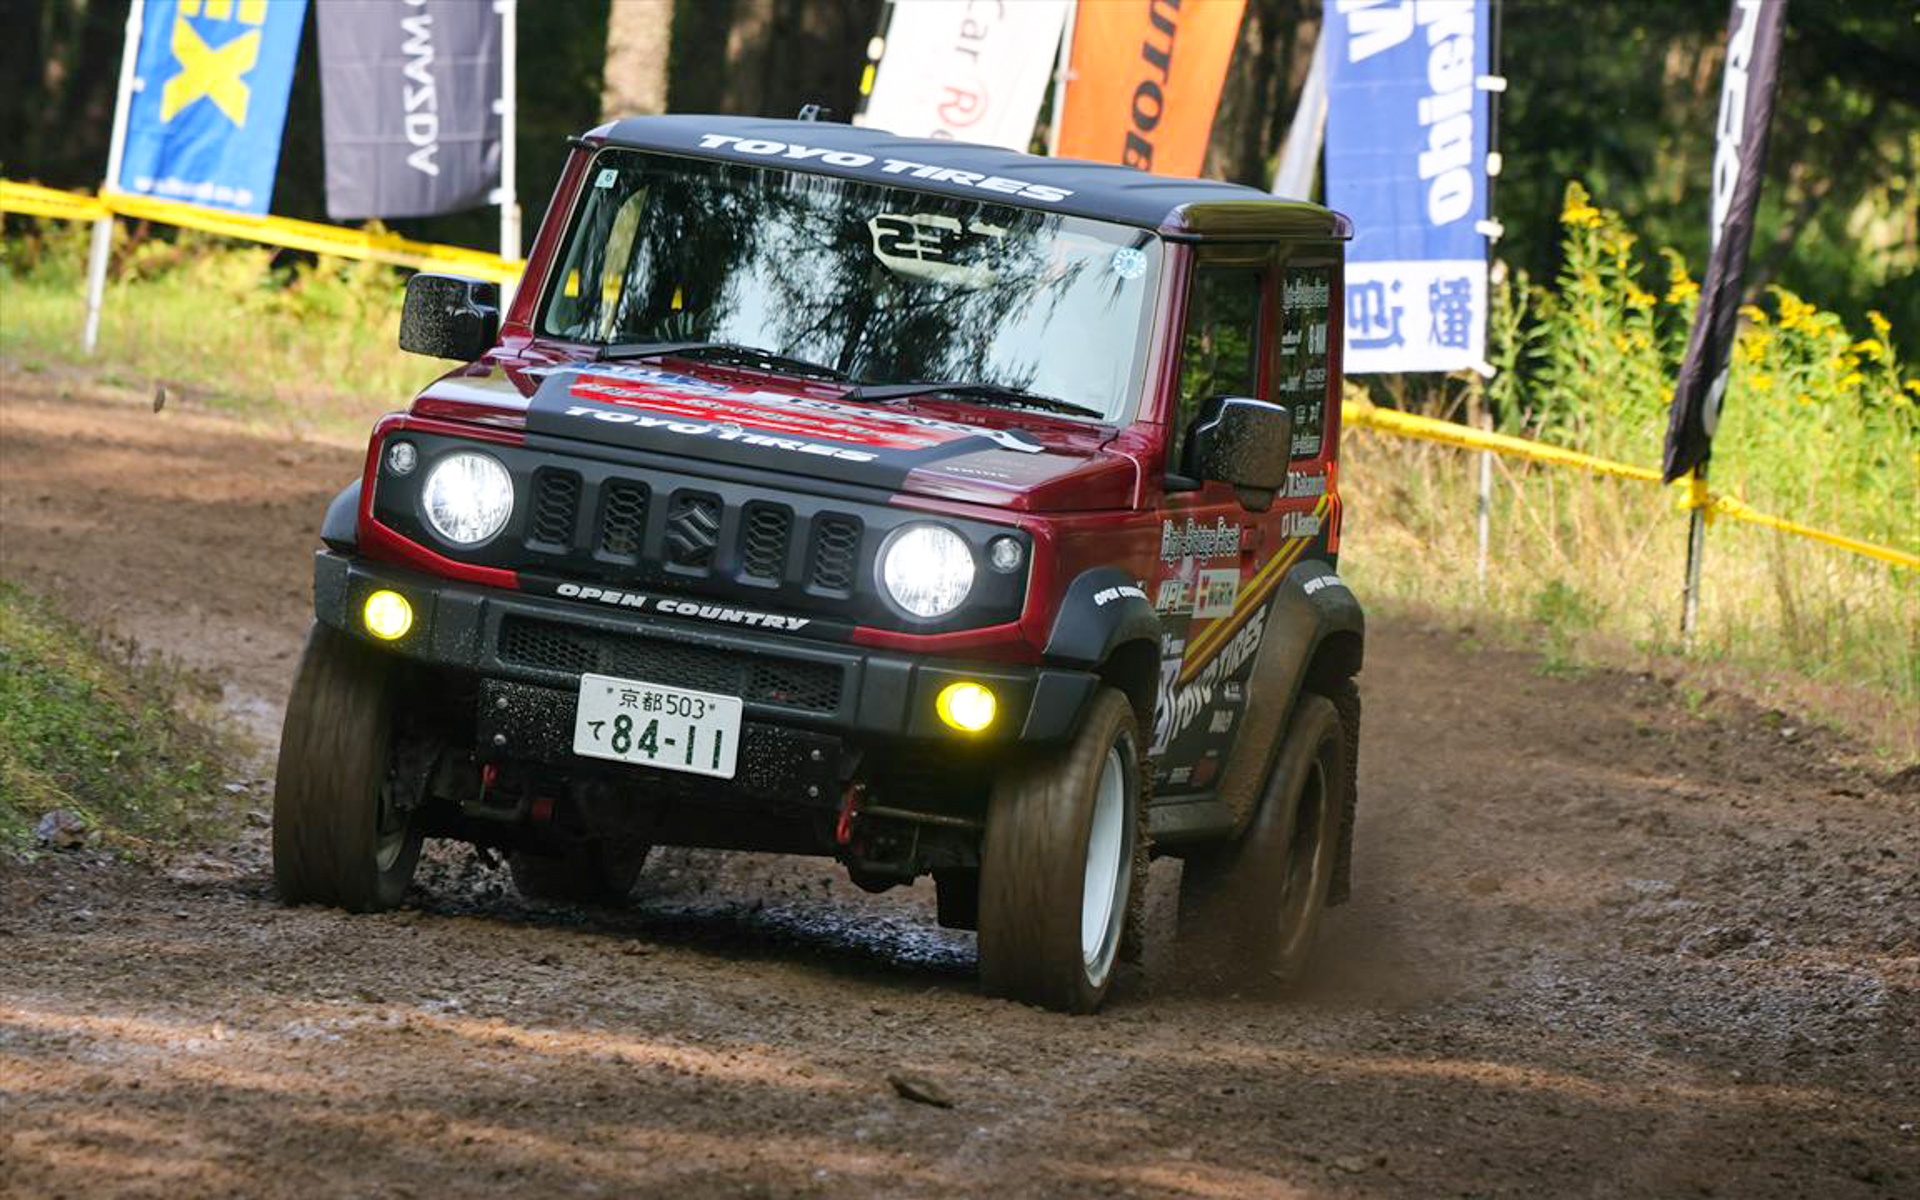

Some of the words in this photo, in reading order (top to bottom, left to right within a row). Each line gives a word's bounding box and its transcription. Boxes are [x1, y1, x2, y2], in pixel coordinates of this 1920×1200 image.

[700, 133, 875, 168] TOYO
[881, 158, 1074, 202] TIRES
[565, 405, 712, 435] TOYO
[711, 421, 879, 462] TIRES
[556, 583, 647, 607] OPEN
[656, 599, 811, 630] COUNTRY
[587, 720, 606, 741] て
[611, 714, 723, 769] 84-11
